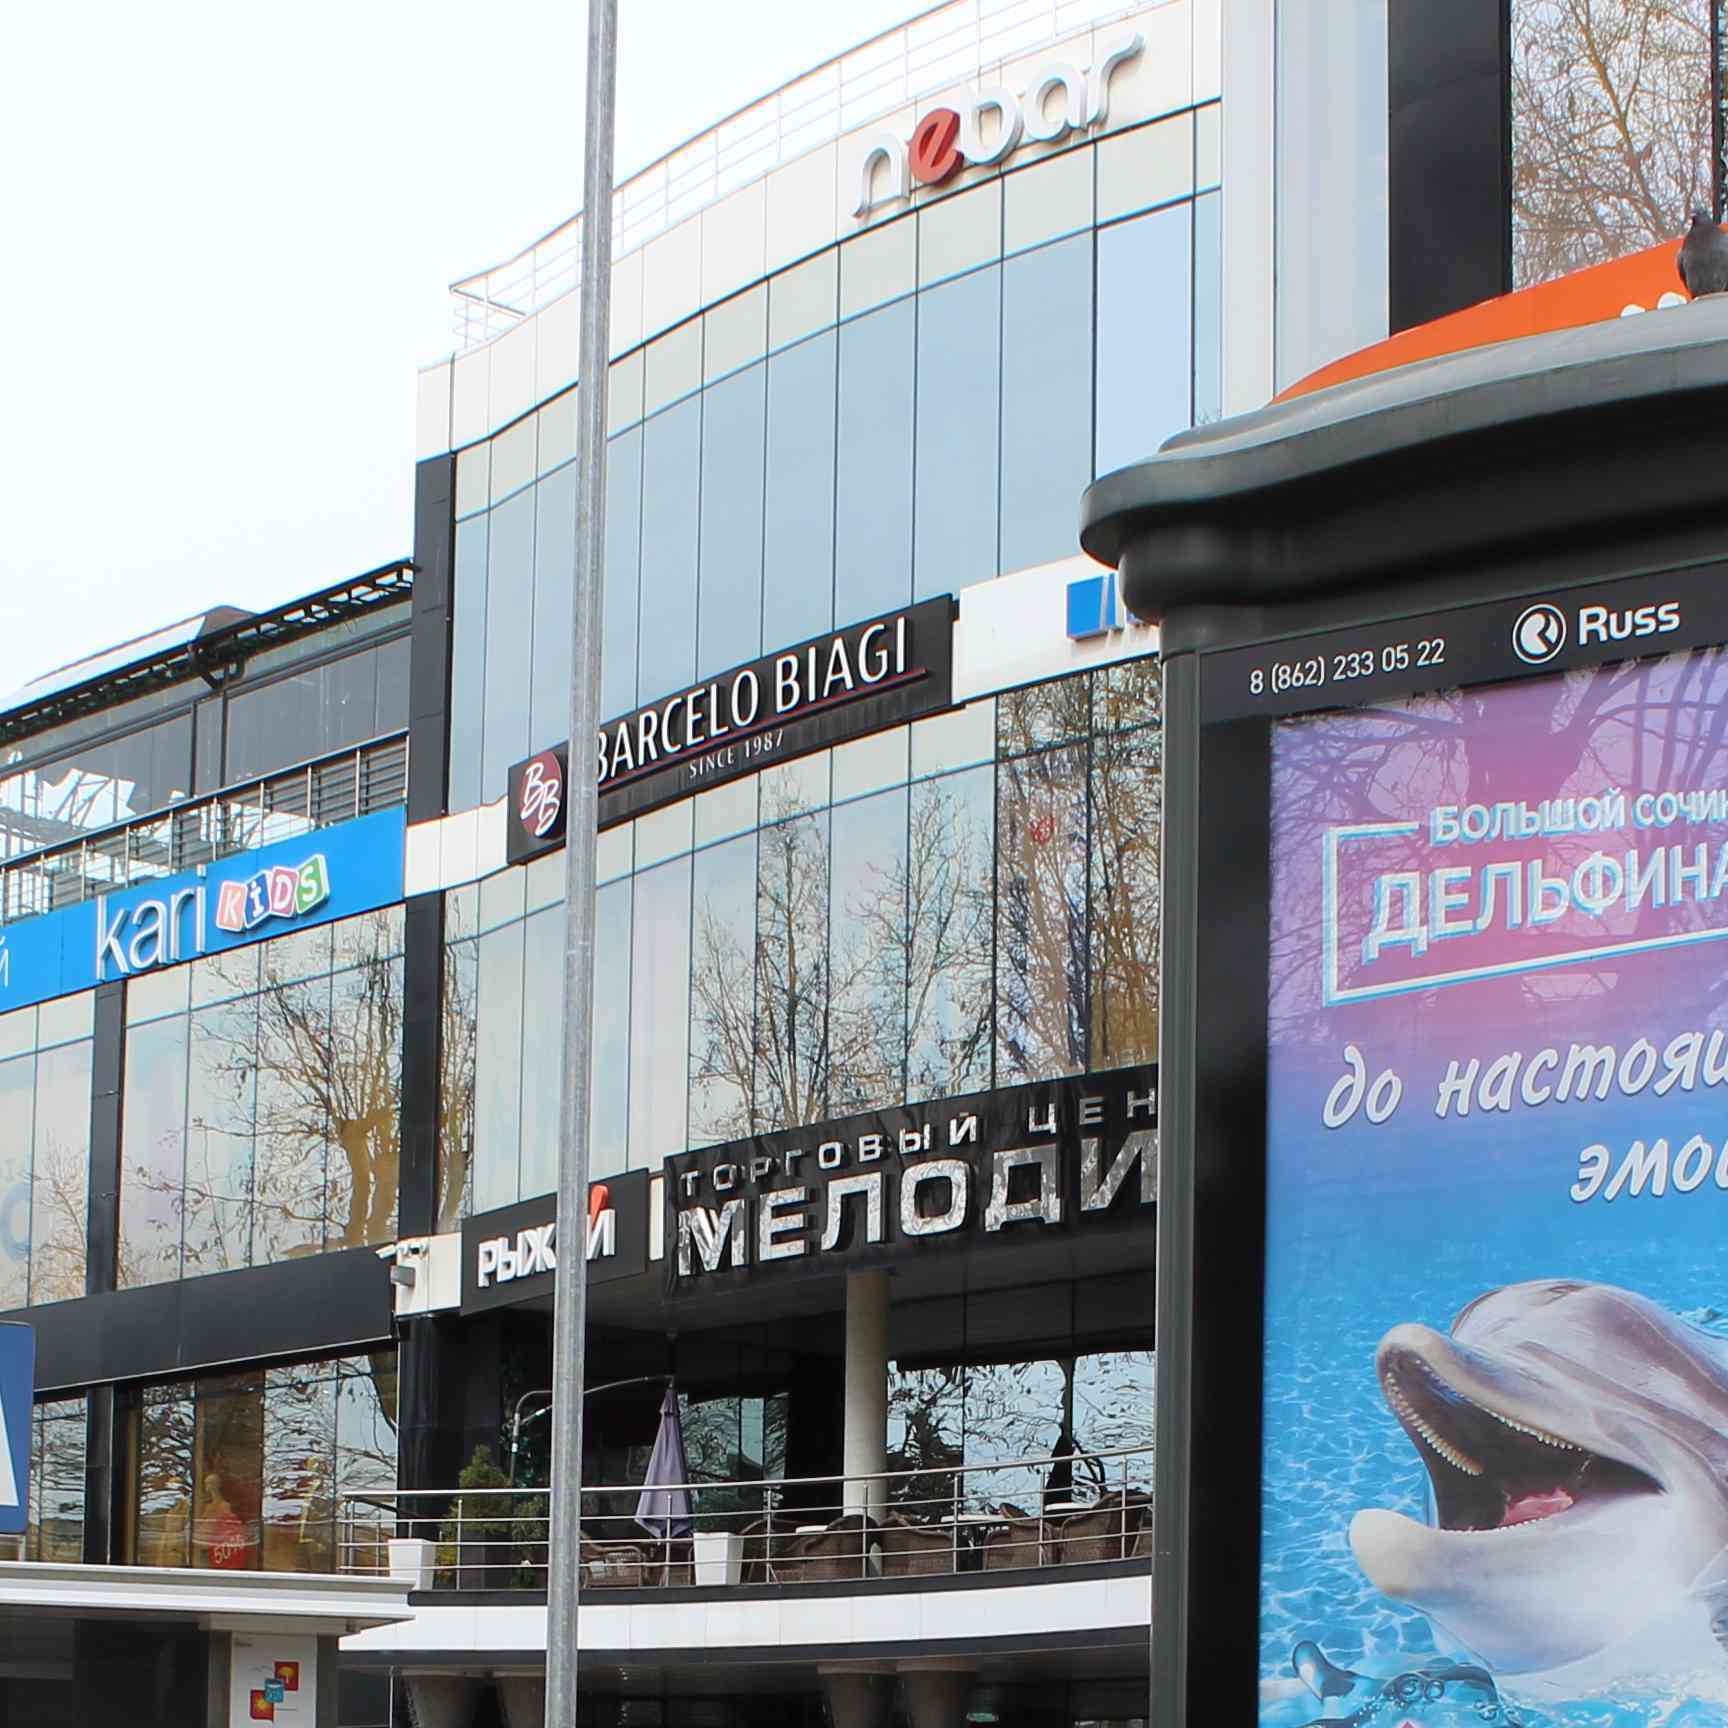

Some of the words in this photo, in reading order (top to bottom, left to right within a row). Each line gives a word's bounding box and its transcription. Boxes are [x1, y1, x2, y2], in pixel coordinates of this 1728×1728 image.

[854, 30, 1145, 220] nebar
[1249, 669, 1264, 695] 8
[1270, 658, 1326, 693] (862)
[1333, 651, 1377, 681] 233
[1381, 646, 1410, 675] 05
[1417, 639, 1446, 667] 22
[1577, 602, 1681, 647] Russ
[597, 668, 760, 784] BARCELO
[775, 615, 909, 714] BIAGI
[688, 748, 736, 780] SINCE
[744, 728, 785, 762] 1987
[1429, 787, 1626, 846] БОЛЬШОЙ
[96, 864, 206, 981] kari
[1322, 1046, 1403, 1128] до
[680, 1111, 978, 1198] ТОРГОВЫЙ
[1027, 1087, 1159, 1136] ЦЕН
[477, 1184, 616, 1288] РЫЖЙ
[676, 1126, 1159, 1277] МЕЛОДИ
